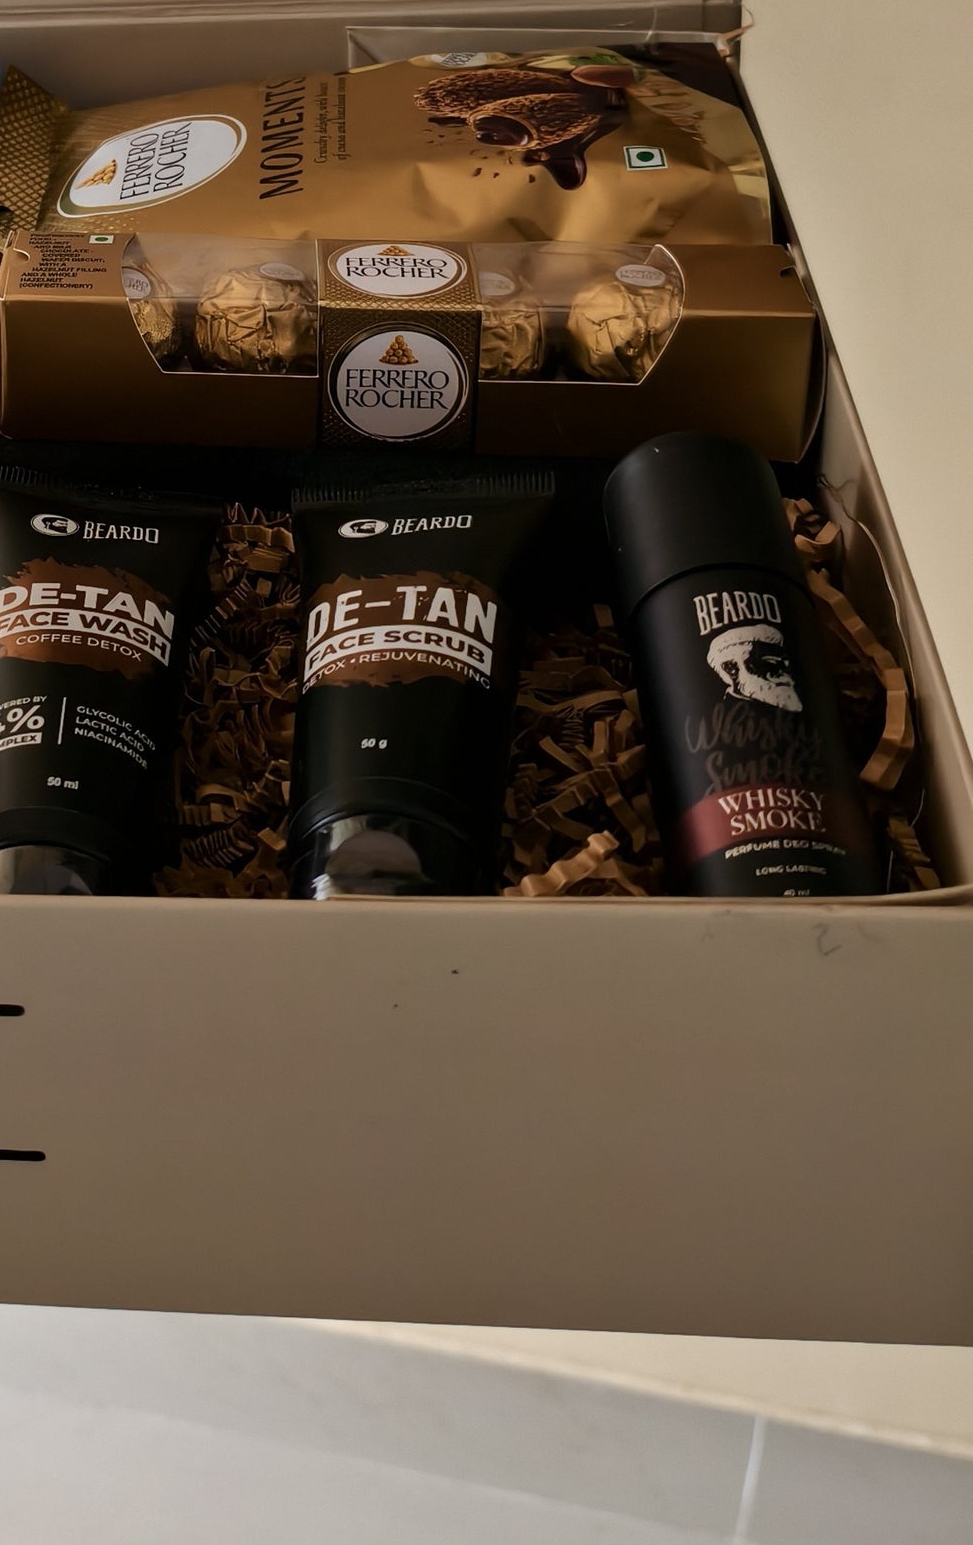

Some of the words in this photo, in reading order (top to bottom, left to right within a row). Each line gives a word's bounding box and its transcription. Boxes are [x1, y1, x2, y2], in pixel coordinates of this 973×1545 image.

[259, 75, 306, 200] MOMENTS
[120, 133, 160, 200] FERRERO
[153, 122, 192, 193] ROCHER
[345, 256, 448, 269] FERRERO
[346, 265, 448, 280] ROCHER
[345, 369, 449, 390] FERRERO
[345, 388, 449, 409] ROCHER
[83, 520, 159, 544] BEARDO
[391, 515, 472, 536] BEARDO
[306, 585, 498, 652] DE-TAN
[693, 591, 782, 636] BEARDO
[16, 633, 82, 647] COFFEE
[88, 638, 142, 662] DETOX
[78, 613, 170, 657] WASH
[308, 631, 376, 671] FACE
[383, 630, 485, 665] SCRUB
[302, 659, 346, 695] DETOX
[359, 651, 491, 691] REJUVENATING
[32, 695, 48, 703] BY
[75, 716, 118, 736] LACTIC
[119, 732, 145, 752] ACID
[76, 705, 133, 732] GLYCOLIC
[134, 729, 156, 751] ACID
[74, 727, 148, 771] NIACINAMIDE
[378, 738, 388, 750] g
[46, 776, 62, 787] 50
[63, 779, 79, 790] ml
[718, 787, 826, 815] WHISKY
[730, 809, 827, 836] SMOKE
[725, 839, 780, 859] PERFUME
[755, 865, 784, 876] LONG
